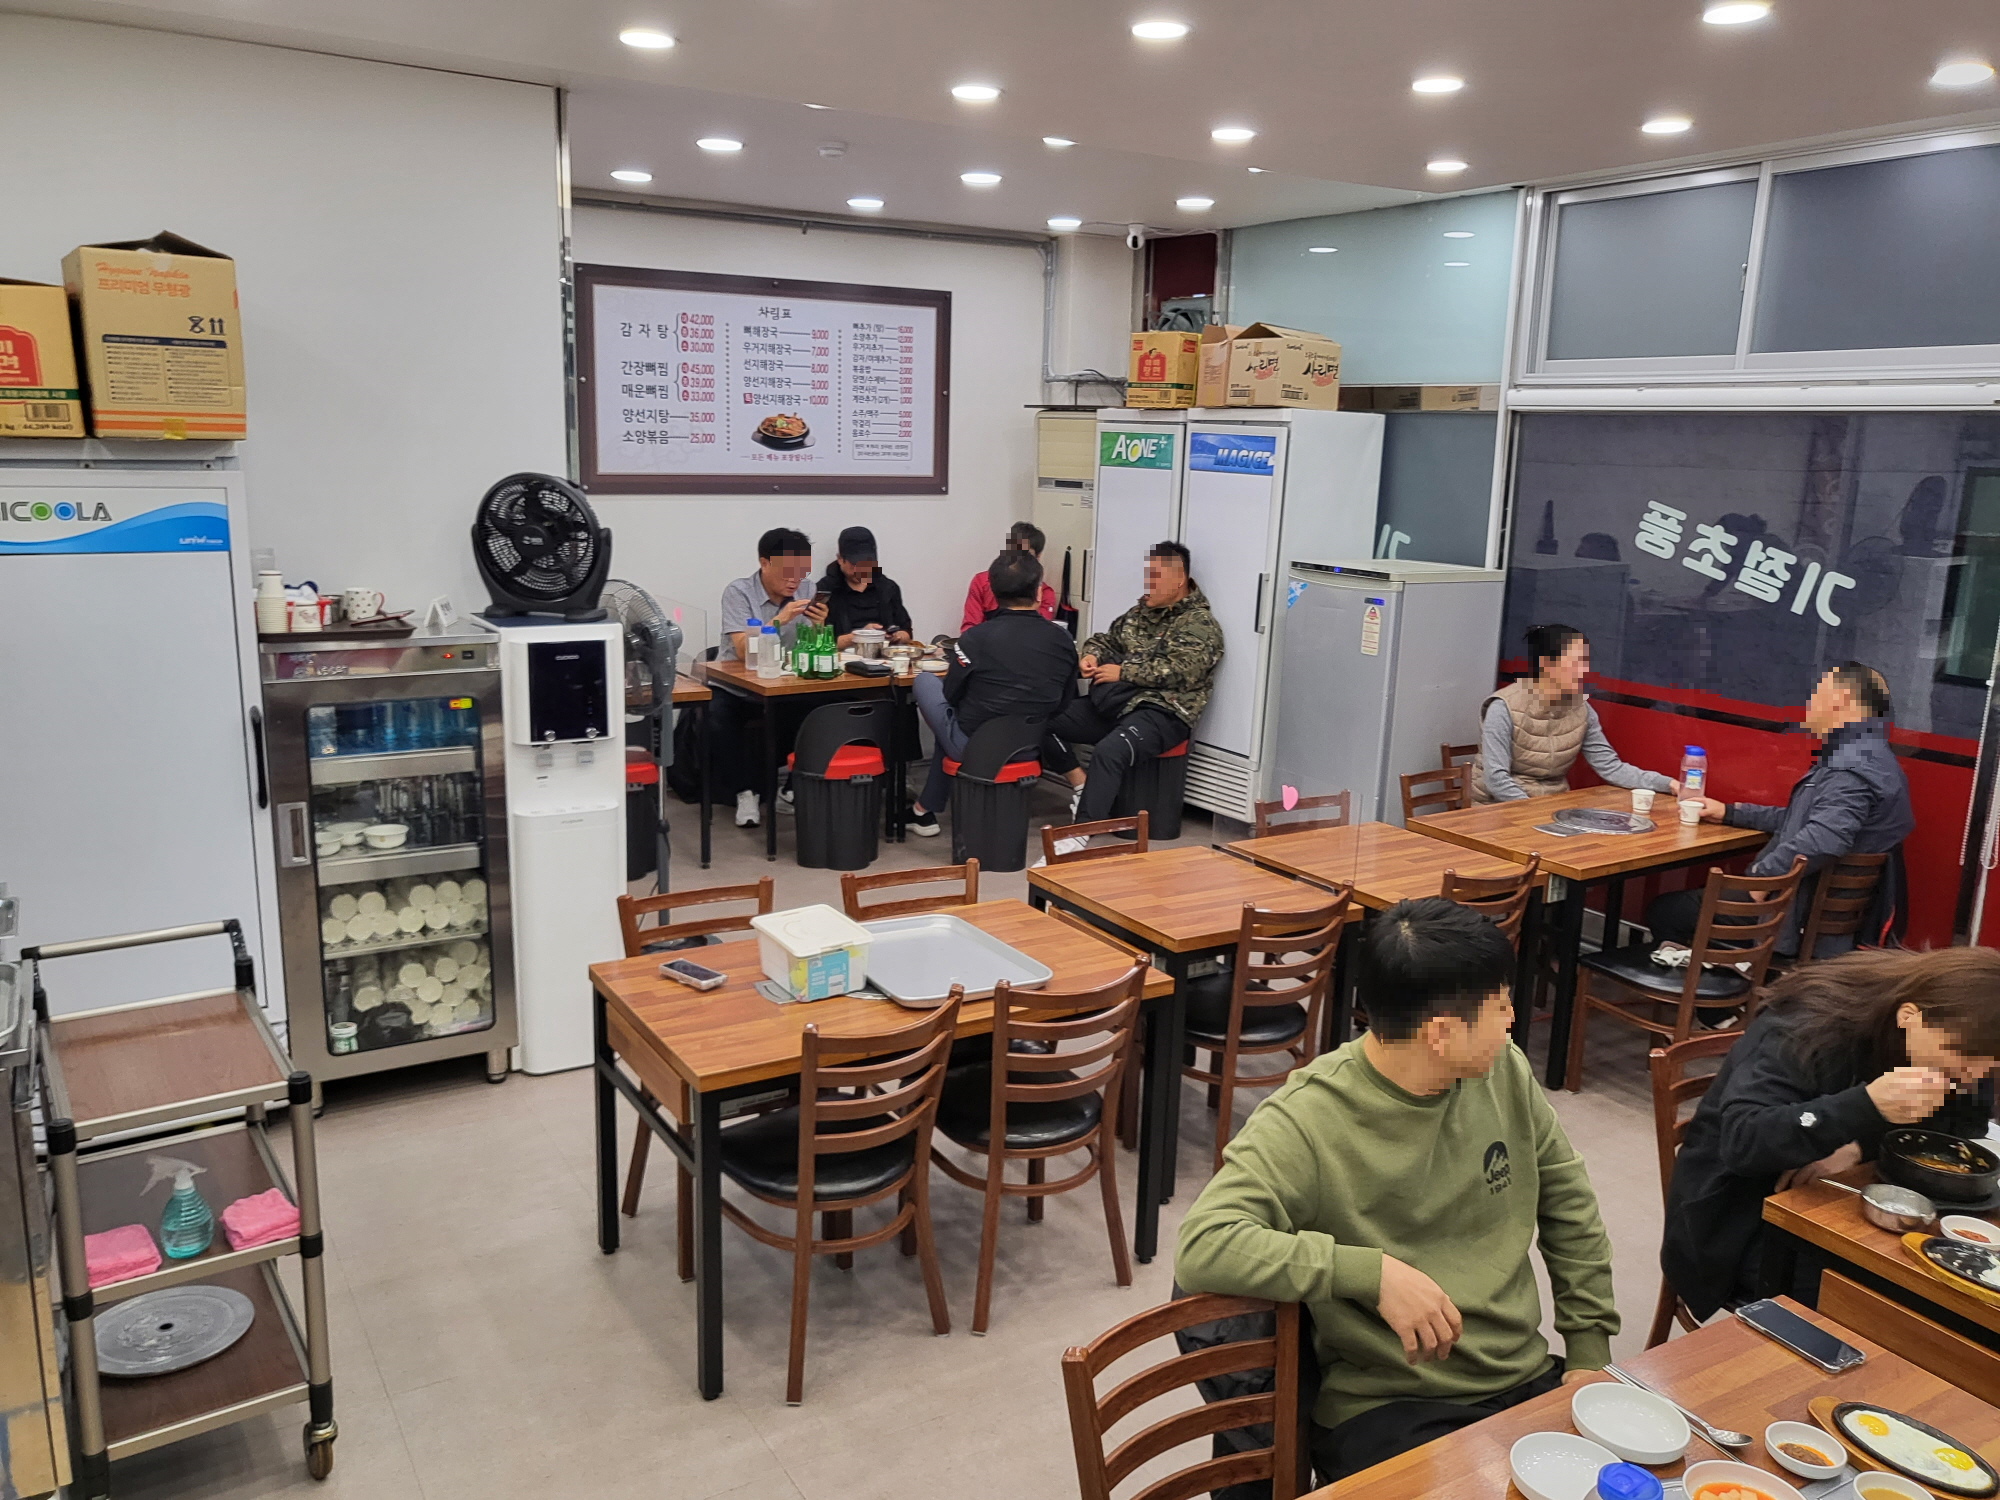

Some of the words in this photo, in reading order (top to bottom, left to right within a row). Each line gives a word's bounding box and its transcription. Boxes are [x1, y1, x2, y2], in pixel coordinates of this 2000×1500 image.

[98, 278, 150, 294] 프리미엄
[690, 314, 715, 325] 42,000
[758, 306, 792, 320] 차림표
[690, 328, 715, 340] 36,000
[811, 329, 829, 341] 9,000
[690, 342, 715, 353] 30,000
[742, 342, 792, 355] 우거지해장국
[811, 346, 829, 358] 7,000
[620, 361, 669, 376] 간장뼈찜
[690, 364, 715, 375] 45,000
[743, 359, 783, 371] 선지해장국
[1302, 360, 1339, 379] 사리면
[690, 378, 715, 389] 39,000
[743, 376, 792, 389] 양선지해장국
[621, 384, 669, 399] 매운뼈찜
[690, 391, 715, 403] 33,000
[753, 394, 801, 406] 양선지해장국
[622, 409, 669, 424] 양선지탕
[690, 412, 715, 424] 35,000
[622, 430, 669, 445] 소양볶음
[690, 433, 715, 444] 25,000
[0, 501, 112, 521] ICOOLA
